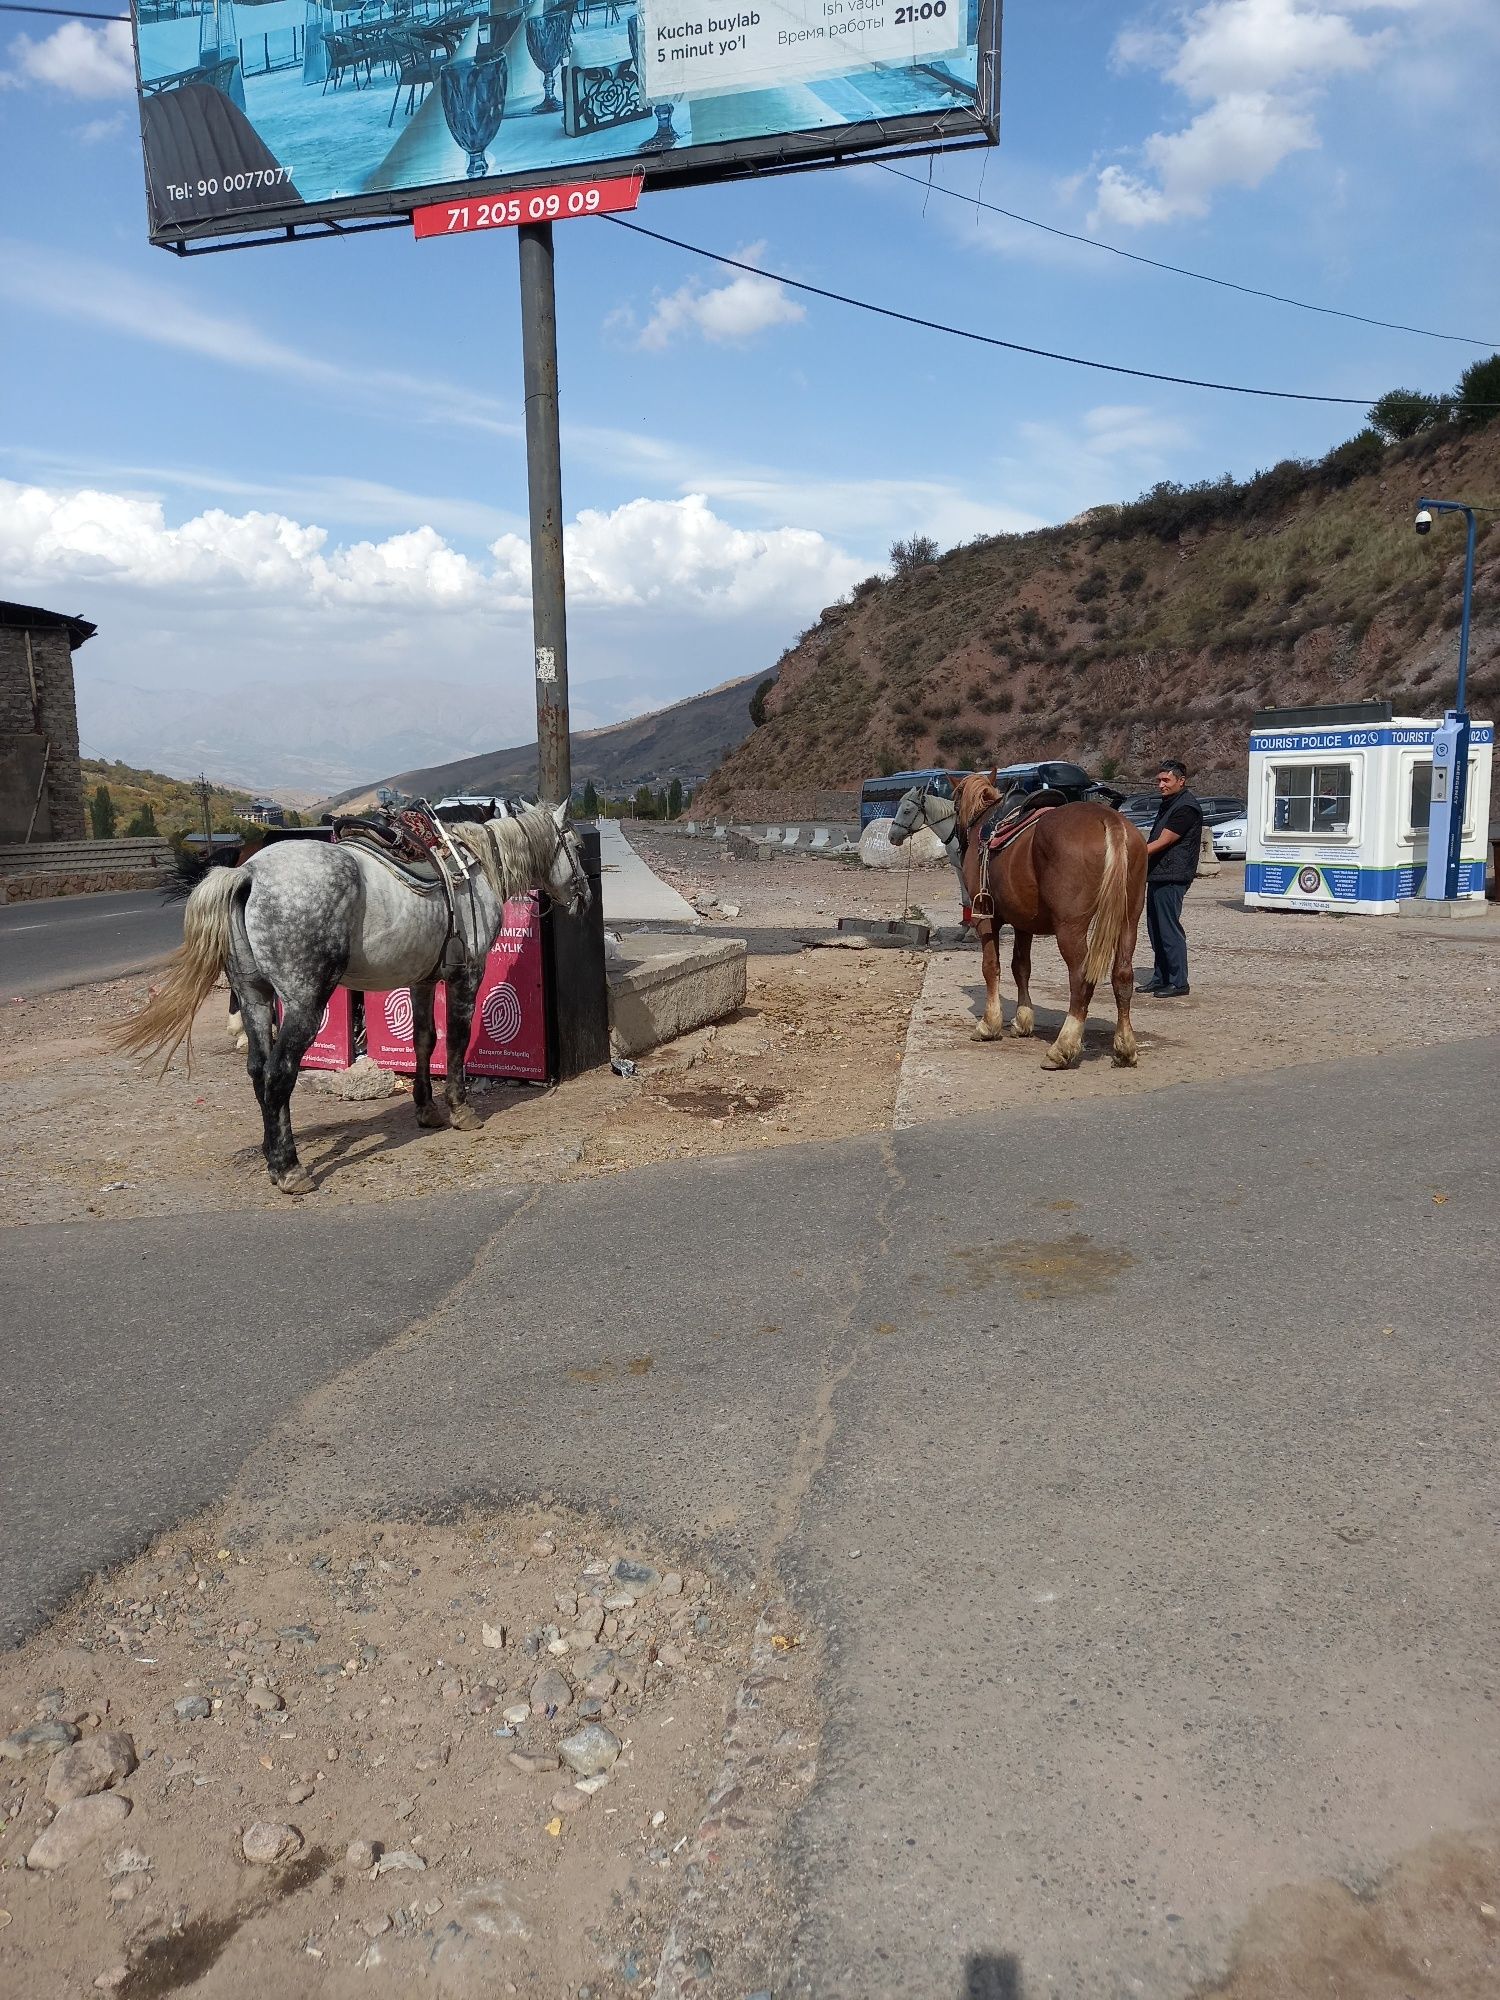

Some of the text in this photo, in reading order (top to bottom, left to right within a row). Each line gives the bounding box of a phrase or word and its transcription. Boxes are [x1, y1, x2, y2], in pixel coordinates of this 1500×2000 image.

[823, 3, 843, 16] Ish
[894, 0, 947, 25] 21:00
[657, 11, 761, 41] Kucha buylab
[778, 17, 884, 45] Время работы
[657, 48, 666, 62] 5
[671, 41, 714, 60] minut
[166, 166, 294, 201] Tel: 90 0077077
[447, 189, 600, 230] 71 205 09 09
[1254, 733, 1367, 750] TOURIST POLICE 102
[1391, 731, 1430, 743] TOURIST
[1470, 730, 1481, 742] 02
[1453, 760, 1461, 804] EMERGENCY
